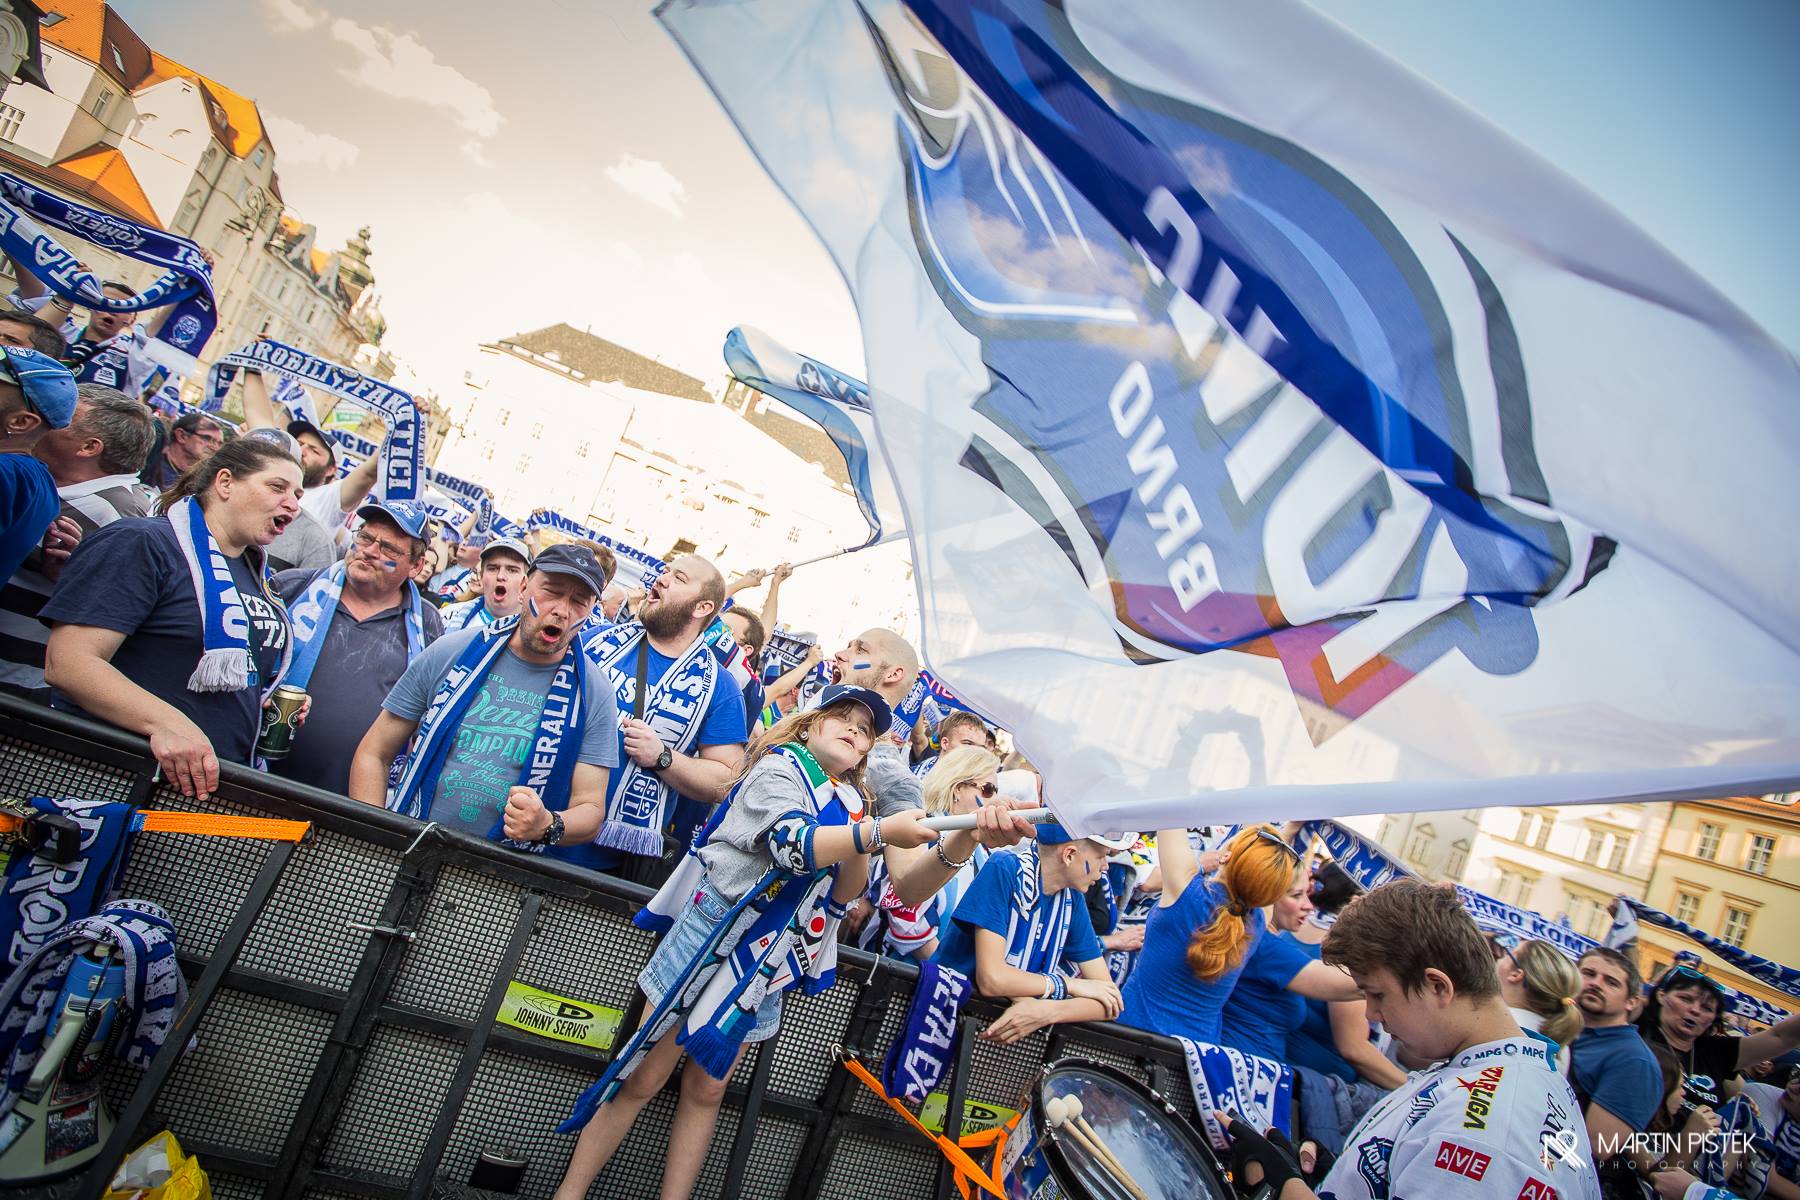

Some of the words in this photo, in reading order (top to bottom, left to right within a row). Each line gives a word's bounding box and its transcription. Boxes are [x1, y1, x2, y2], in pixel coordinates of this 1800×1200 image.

[65, 209, 147, 247] KOMETA
[434, 472, 485, 501] BRNO
[526, 510, 613, 547] KOMETA
[615, 542, 668, 573] BRNO
[463, 684, 542, 730] Deni
[455, 728, 533, 766] OMPAN
[527, 694, 571, 797] ENERALI
[513, 1006, 554, 1032] JOHNNY
[553, 1018, 591, 1040] SERVIS
[1474, 1047, 1502, 1061] MPG
[1522, 1046, 1545, 1060] MPG
[1363, 1141, 1389, 1177] KOM
[1363, 1164, 1381, 1185] BRNO
[1436, 1147, 1489, 1176] AVE
